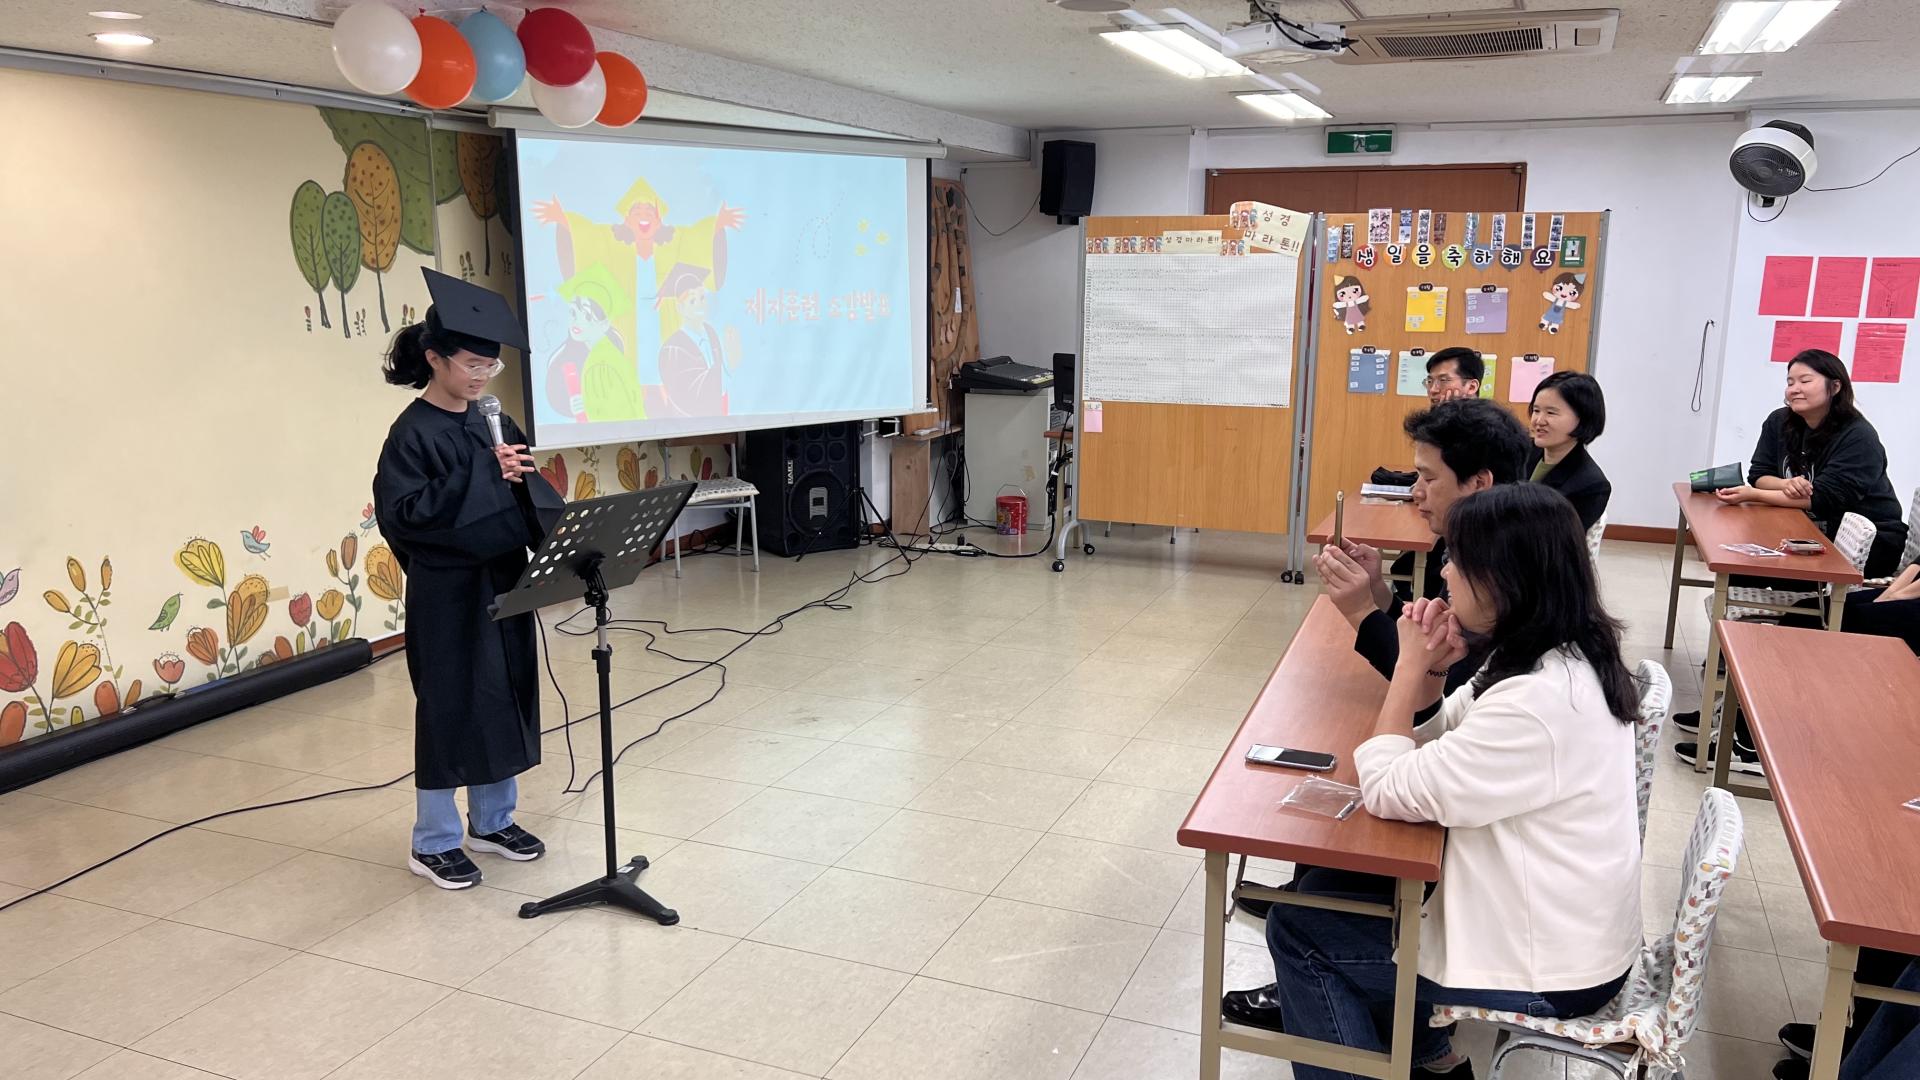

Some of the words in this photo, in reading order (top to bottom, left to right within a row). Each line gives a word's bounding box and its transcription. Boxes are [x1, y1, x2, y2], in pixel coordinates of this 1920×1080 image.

[1262, 209, 1291, 227] 성경
[1244, 229, 1300, 253] 마라톤!!
[1357, 245, 1431, 266] 생일을
[1446, 246, 1553, 267] 축하해요
